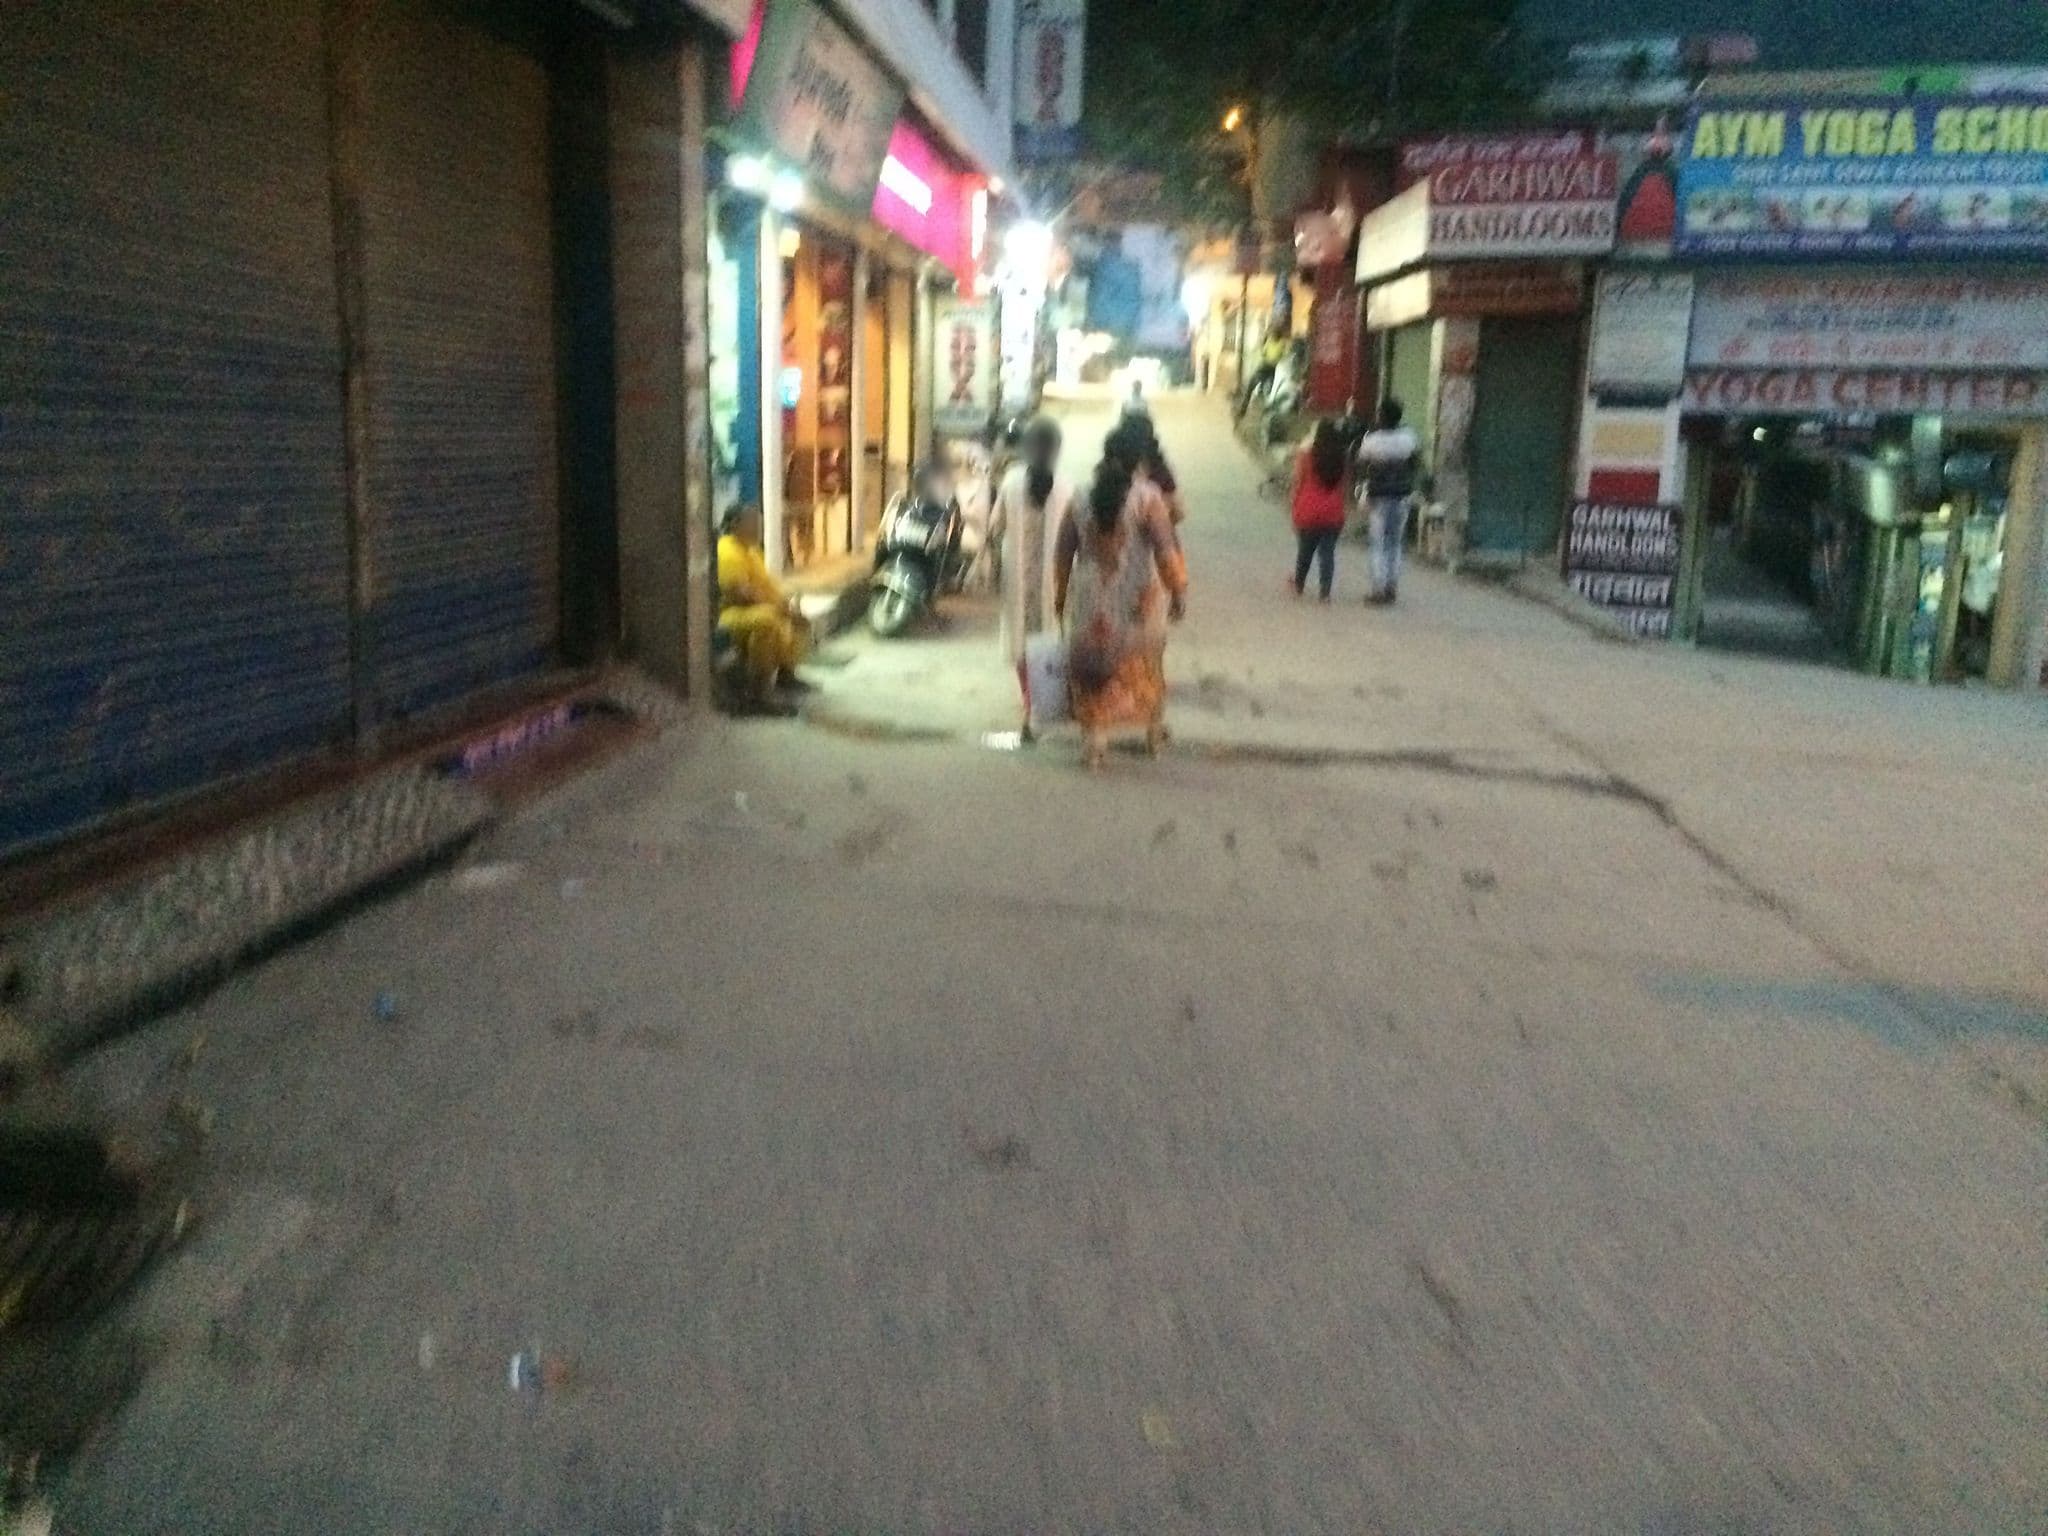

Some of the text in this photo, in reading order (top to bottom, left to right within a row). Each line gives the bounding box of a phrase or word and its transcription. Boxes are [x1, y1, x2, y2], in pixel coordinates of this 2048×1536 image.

[1692, 110, 1786, 157] AYM
[1802, 108, 1916, 156] YOGA
[1686, 369, 1816, 406] YOGA
